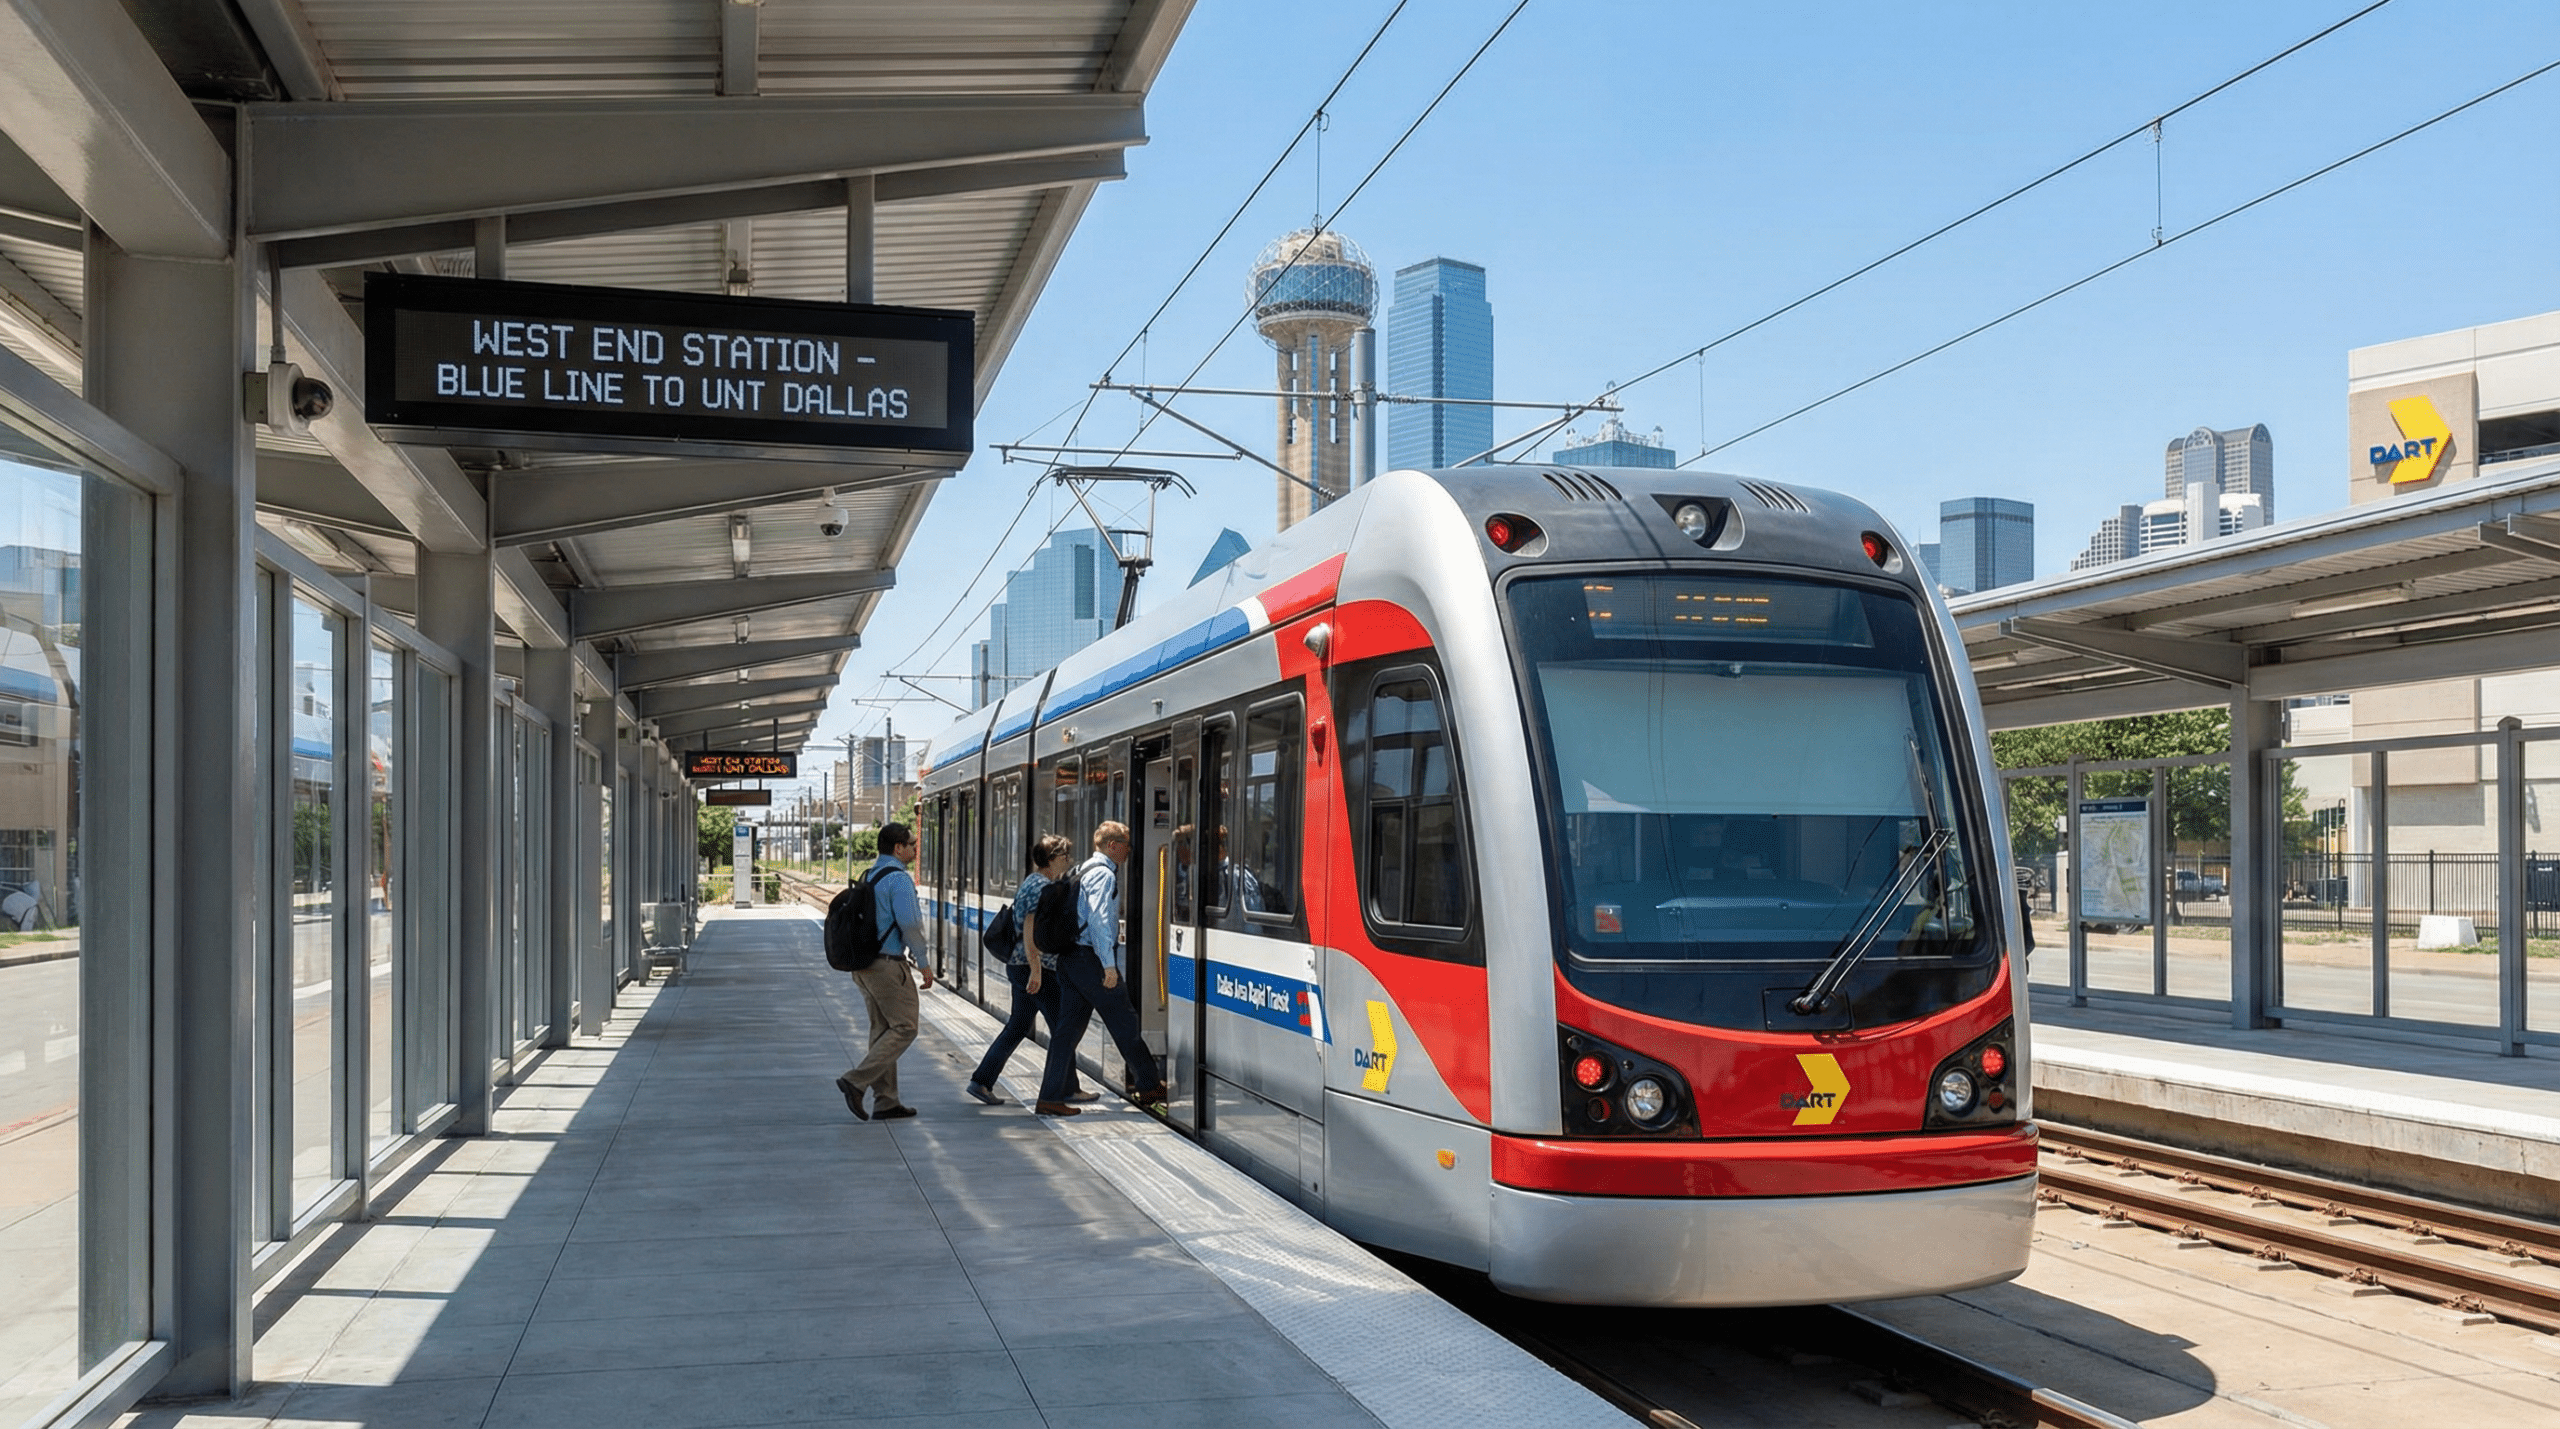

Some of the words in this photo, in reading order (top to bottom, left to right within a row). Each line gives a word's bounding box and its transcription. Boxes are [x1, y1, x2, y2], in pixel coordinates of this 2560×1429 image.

[473, 320, 574, 359] WEST
[593, 327, 664, 365] END
[683, 332, 839, 375] STATION
[437, 363, 526, 399] BLUE
[544, 369, 624, 404] LINE
[642, 374, 684, 407] TO
[702, 377, 766, 411] UNT
[783, 382, 908, 419] DALLAS
[2370, 437, 2438, 465] DART
[1354, 1047, 1388, 1072] DART
[1780, 1092, 1837, 1110] DART
